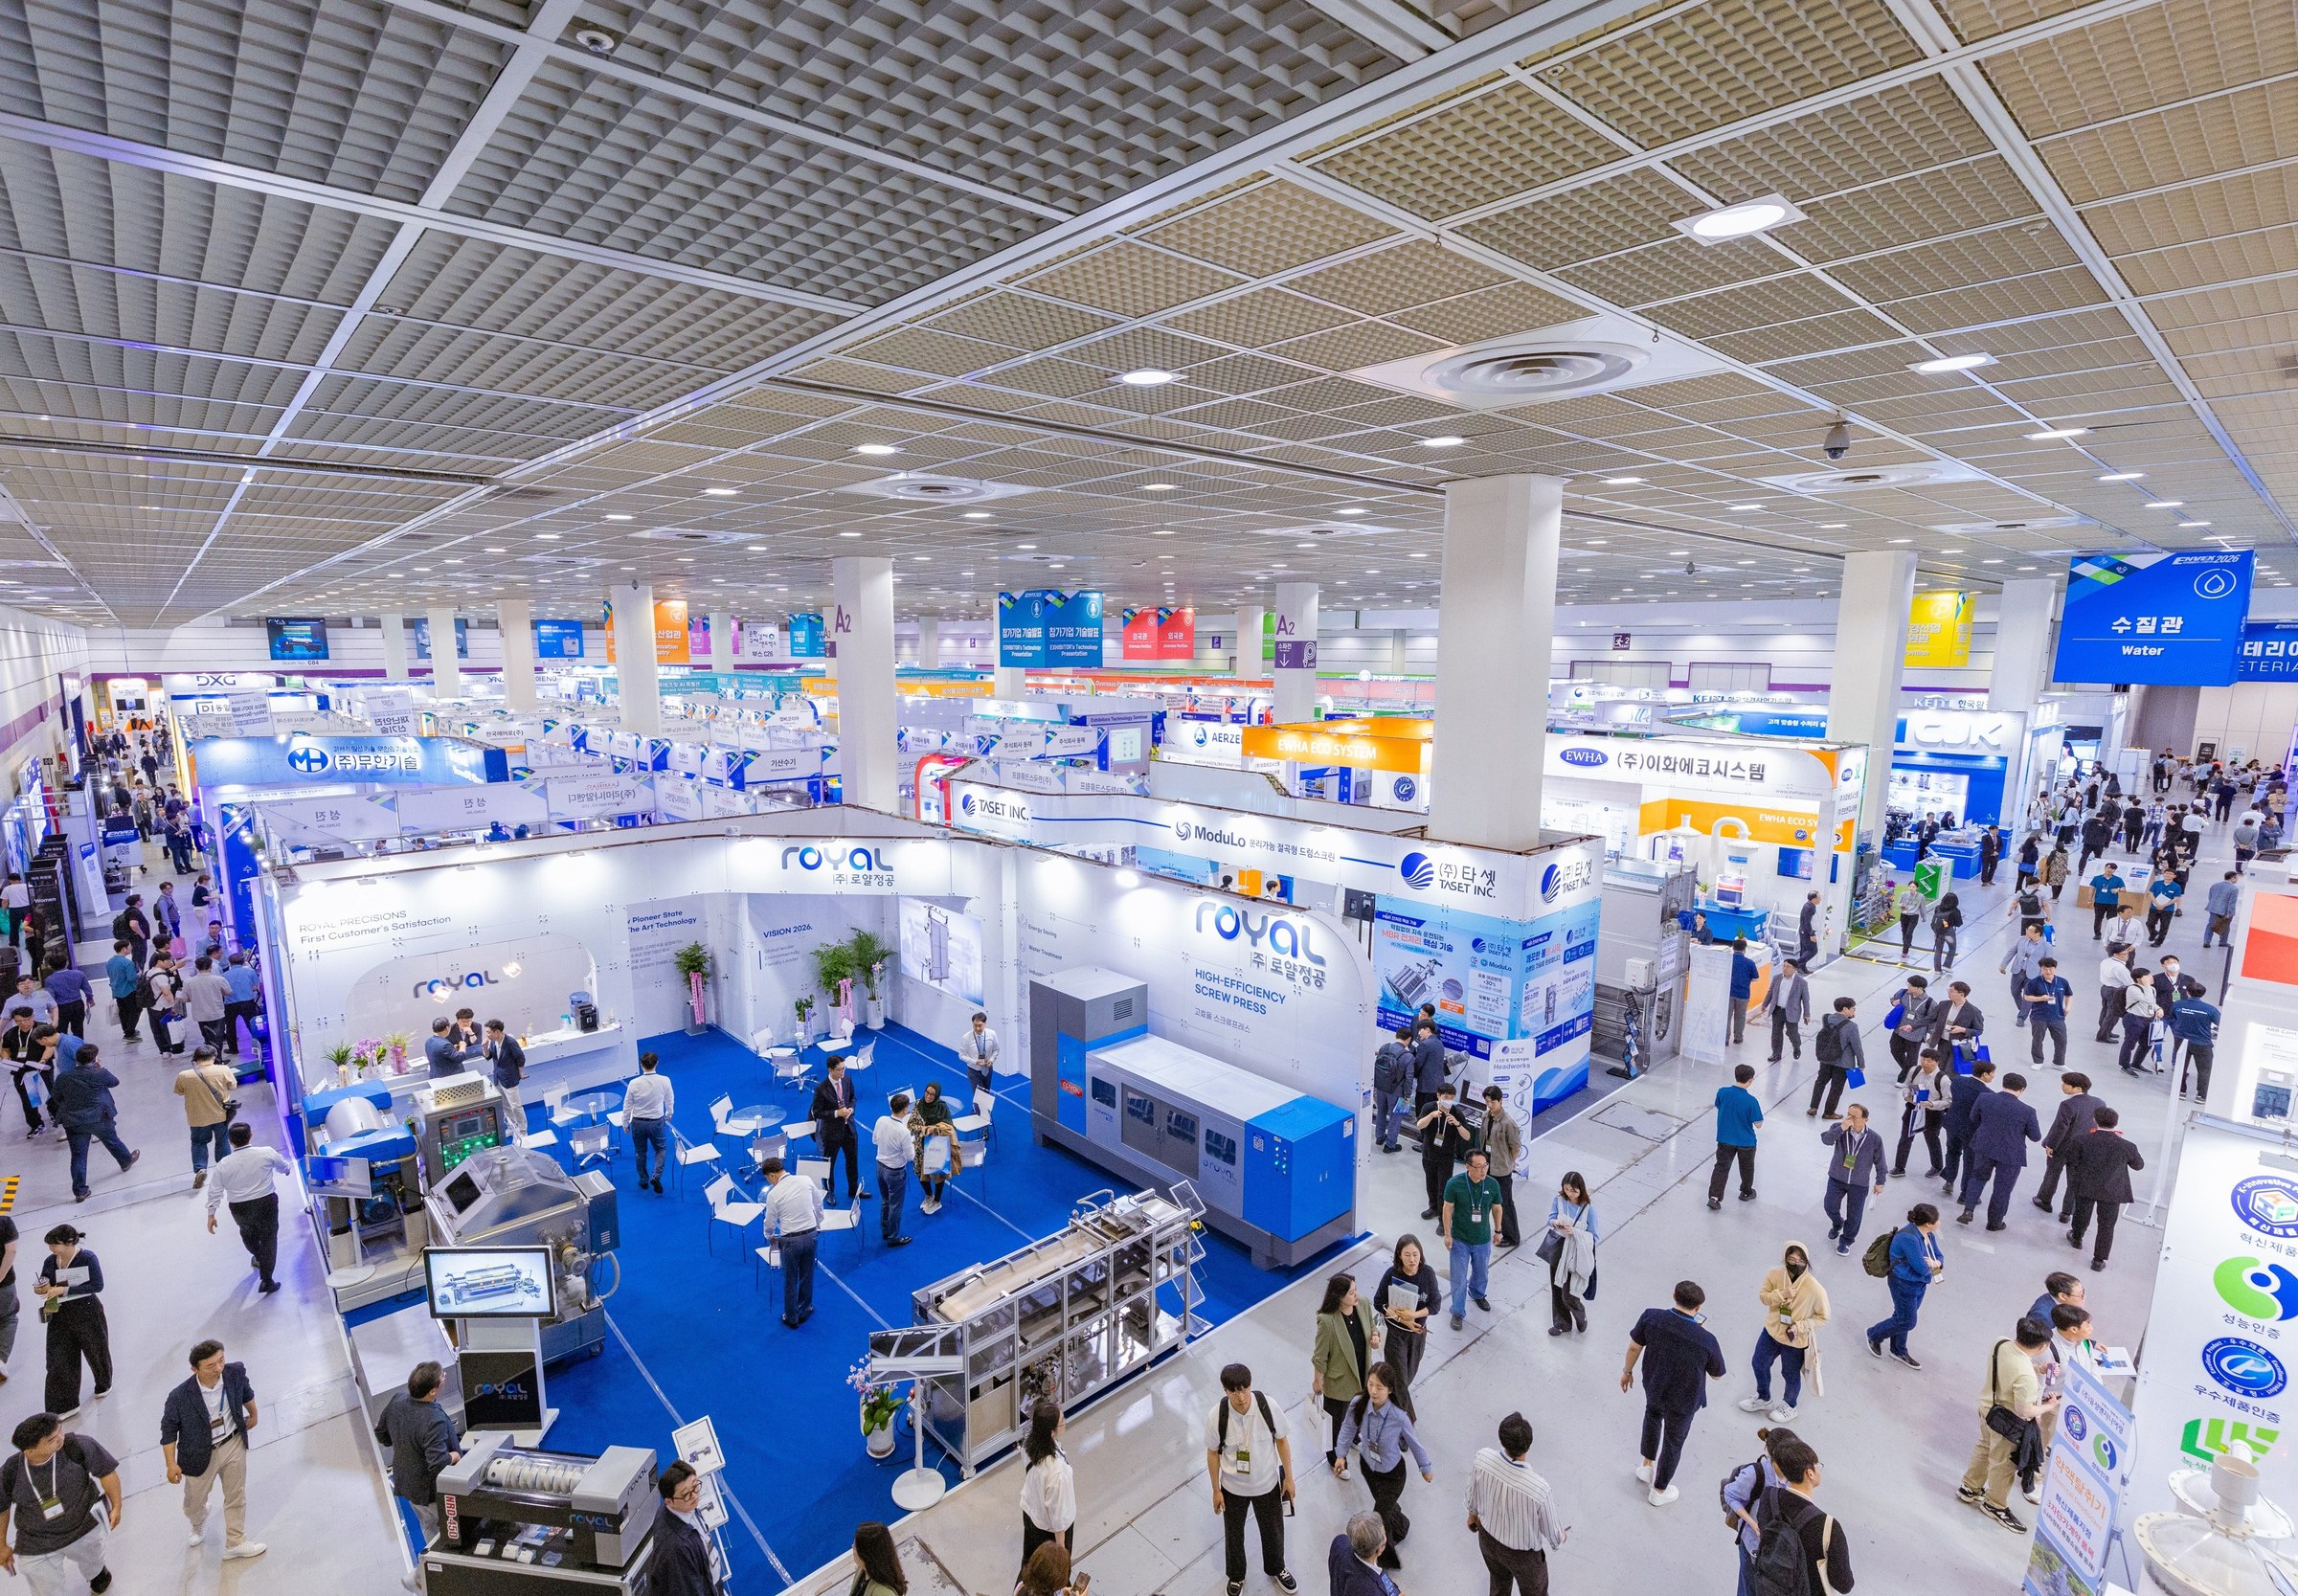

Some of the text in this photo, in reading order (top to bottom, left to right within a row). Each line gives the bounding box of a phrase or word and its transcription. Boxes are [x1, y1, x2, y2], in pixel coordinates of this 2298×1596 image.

[835, 605, 851, 633] A2
[1276, 615, 1295, 636] A2
[1049, 627, 1099, 639] 참가기업 기술발표
[2122, 645, 2164, 656] Water
[196, 674, 237, 686] DXG
[1212, 732, 1242, 744] AERZE
[1278, 739, 1377, 759] EWHA ECO SYSTEM
[1566, 751, 1603, 763] EWHA
[333, 754, 418, 771] (주)무한기술
[771, 757, 797, 768] 기산수기
[1617, 752, 1766, 781] (주)이화에코시스템
[979, 798, 1029, 821] TASET INC.
[1759, 814, 1786, 825] EWHA
[1788, 817, 1805, 826] ECO
[1194, 826, 1336, 863] ModuLo 분리가능 절곡형 드럼스크린
[851, 873, 895, 888] 로얄정공
[1439, 879, 1496, 898] TASET INC.
[1562, 878, 1580, 892] TASET
[300, 910, 407, 933] ROYAL PRECISIONS
[632, 909, 683, 925] Pioneer State
[642, 922, 654, 932] Art
[655, 916, 697, 931] Technology
[300, 915, 452, 945] First Customer's Satisfaction
[763, 927, 792, 938] VISION
[1028, 923, 1057, 938] Energy Saving
[1382, 930, 1453, 953] MBR 전처리 핵심 기술
[1028, 944, 1063, 960] Water Treatment
[1270, 958, 1326, 991] 로얄정공
[1489, 960, 1512, 972] ModuLo
[1195, 968, 1286, 1005] HIGH-EFFICIENCY
[1195, 984, 1267, 1016] SCREW PRESS
[1194, 1006, 1251, 1034] 고효율 스크류프레스
[2222, 1313, 2282, 1340] 성능인증
[2194, 1384, 2281, 1425] 우수제품인증
[2055, 1454, 2106, 1518] 약액탈취기
[443, 1495, 460, 1540] NRD-450
[2055, 1493, 2092, 1540] 혁신제품지정
